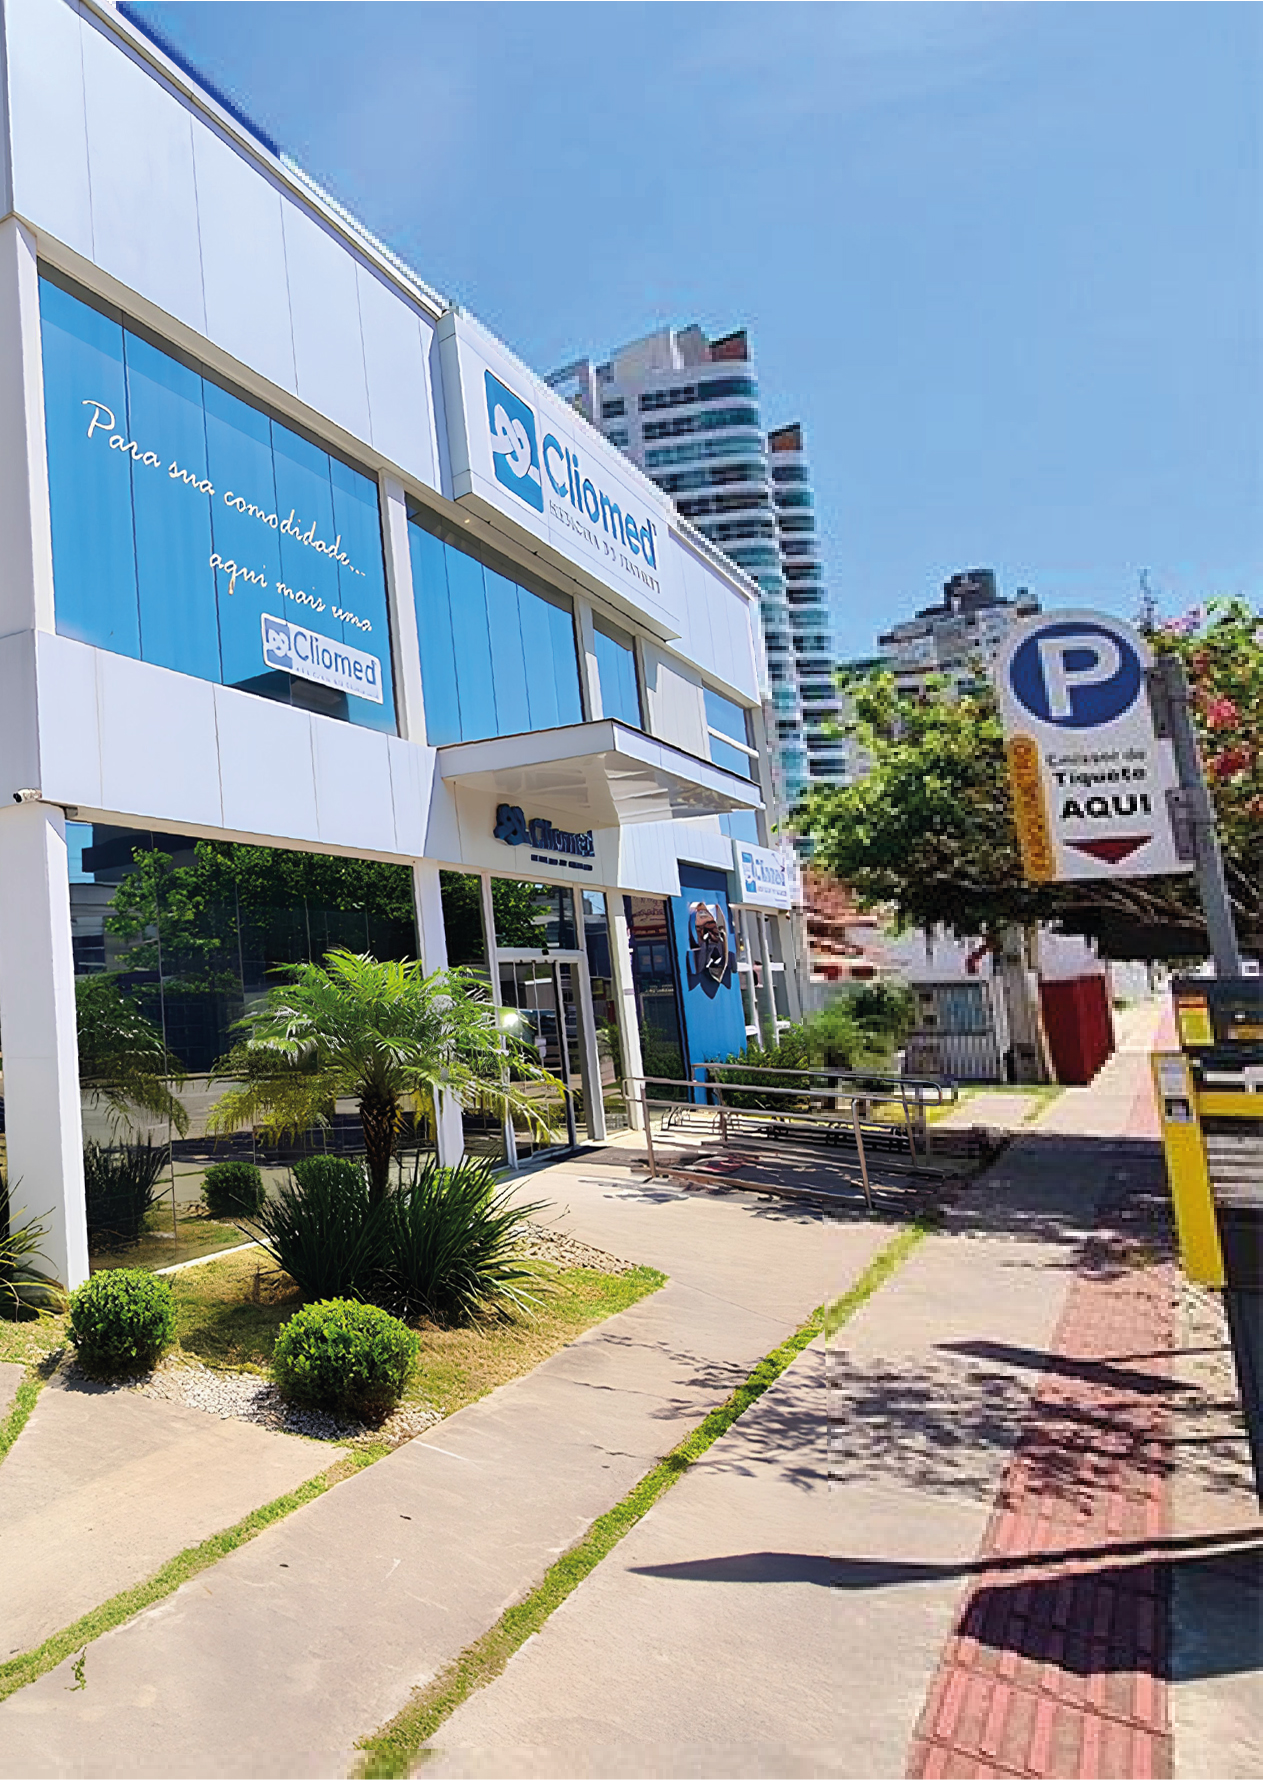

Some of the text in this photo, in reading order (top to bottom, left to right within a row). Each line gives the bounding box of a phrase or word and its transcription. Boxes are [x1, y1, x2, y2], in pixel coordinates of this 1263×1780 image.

[82, 399, 161, 468] Para
[168, 461, 215, 496] sua
[542, 433, 657, 571] Cliomed
[209, 553, 373, 632] aqui mais uma
[293, 630, 377, 686] Cliomed
[1038, 636, 1122, 718] P
[1061, 793, 1152, 819] AQUI
